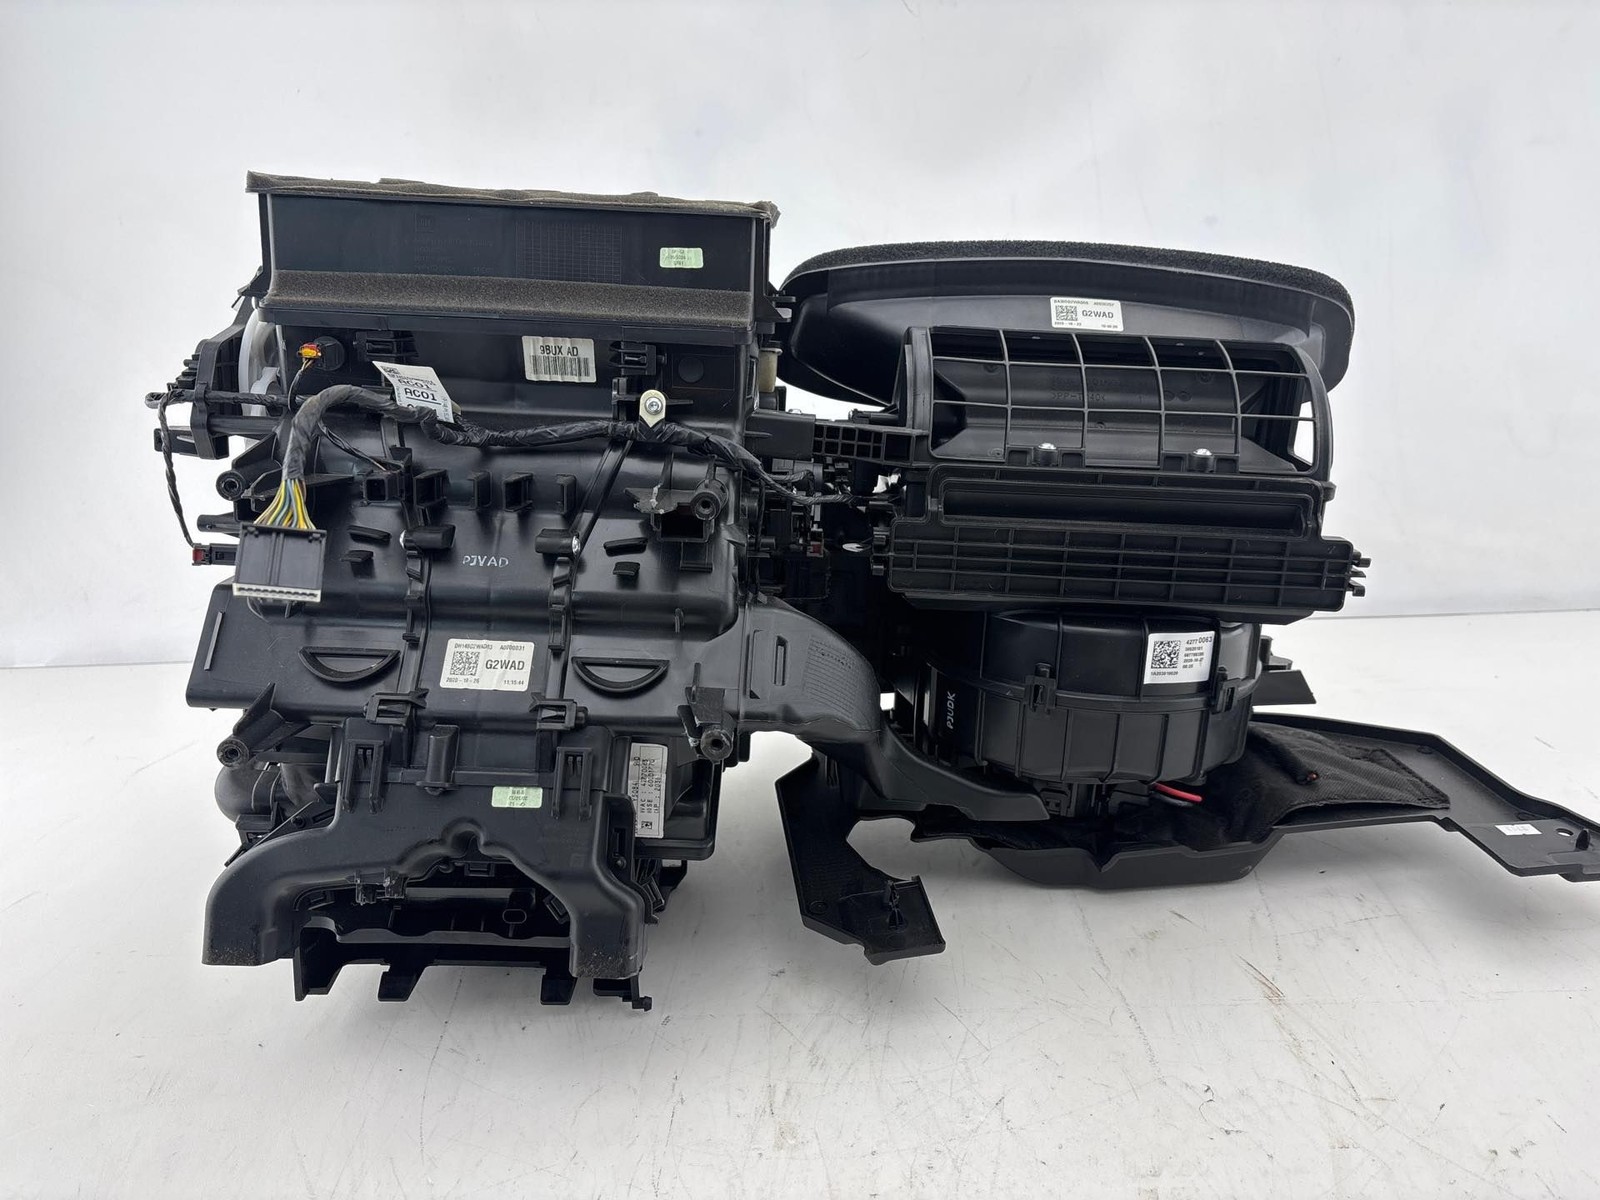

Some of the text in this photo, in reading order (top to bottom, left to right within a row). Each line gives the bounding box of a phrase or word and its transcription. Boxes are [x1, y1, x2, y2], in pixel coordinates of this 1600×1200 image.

[1081, 309, 1114, 319] G2WAD
[567, 346, 579, 357] AD
[462, 555, 509, 567] PJVAD
[485, 659, 525, 671] G2WAD
[946, 691, 956, 729] PJUDK
